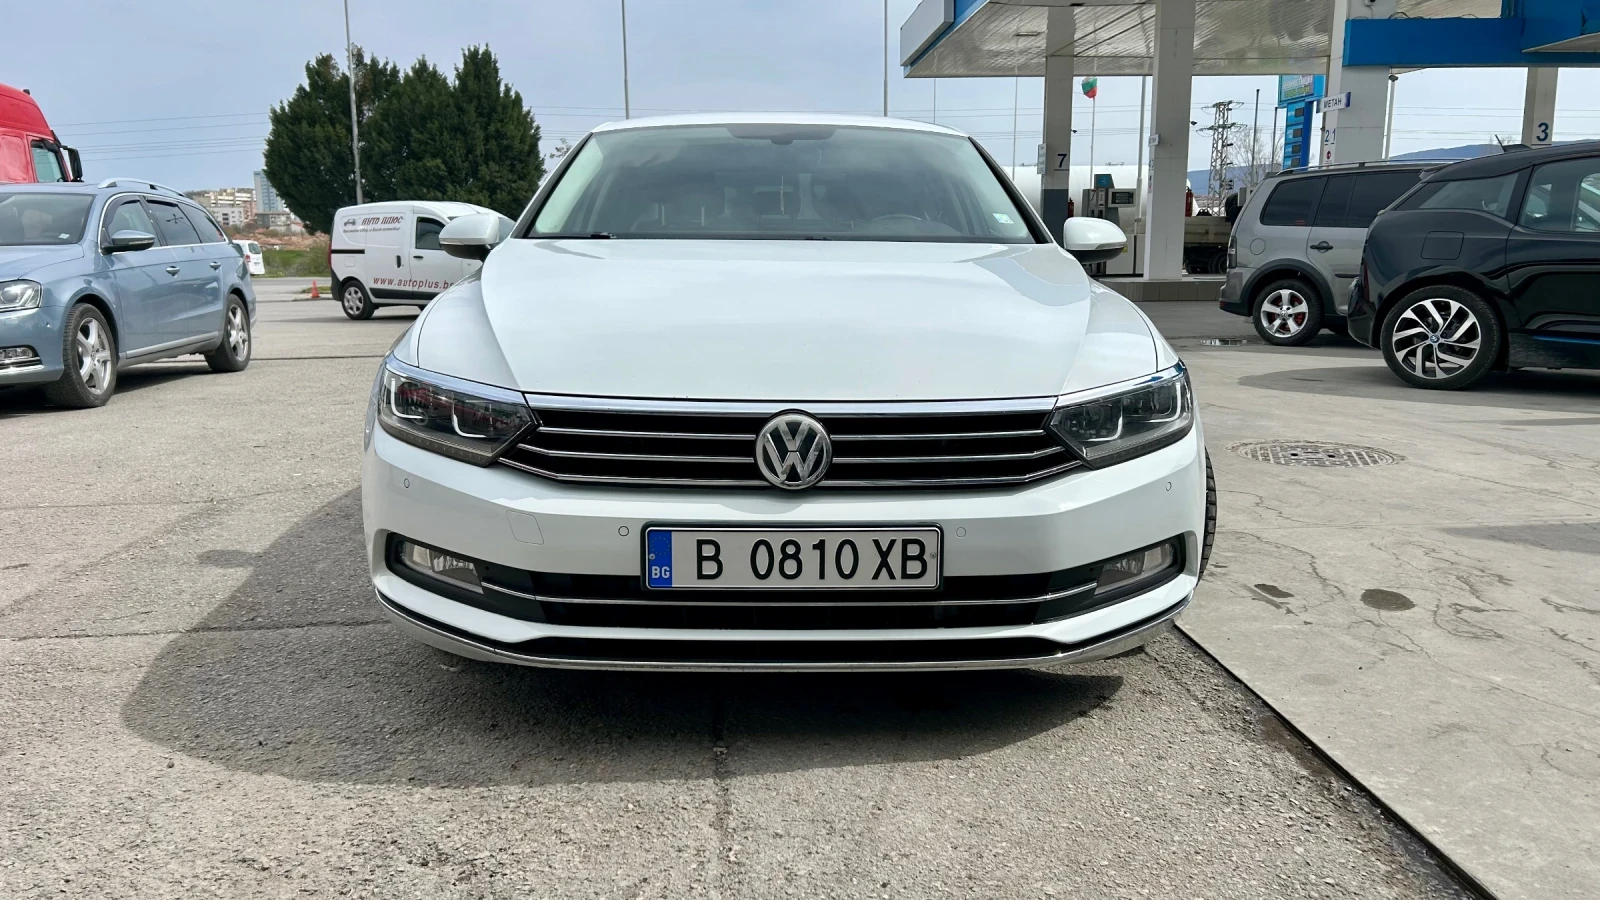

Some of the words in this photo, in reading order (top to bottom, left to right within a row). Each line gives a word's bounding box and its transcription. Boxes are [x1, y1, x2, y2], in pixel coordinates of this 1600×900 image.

[1536, 121, 1549, 142] 3
[1057, 153, 1067, 168] 7
[696, 538, 723, 580] B
[750, 538, 859, 580] 0810
[871, 538, 928, 580] XB
[651, 566, 670, 579] BG
